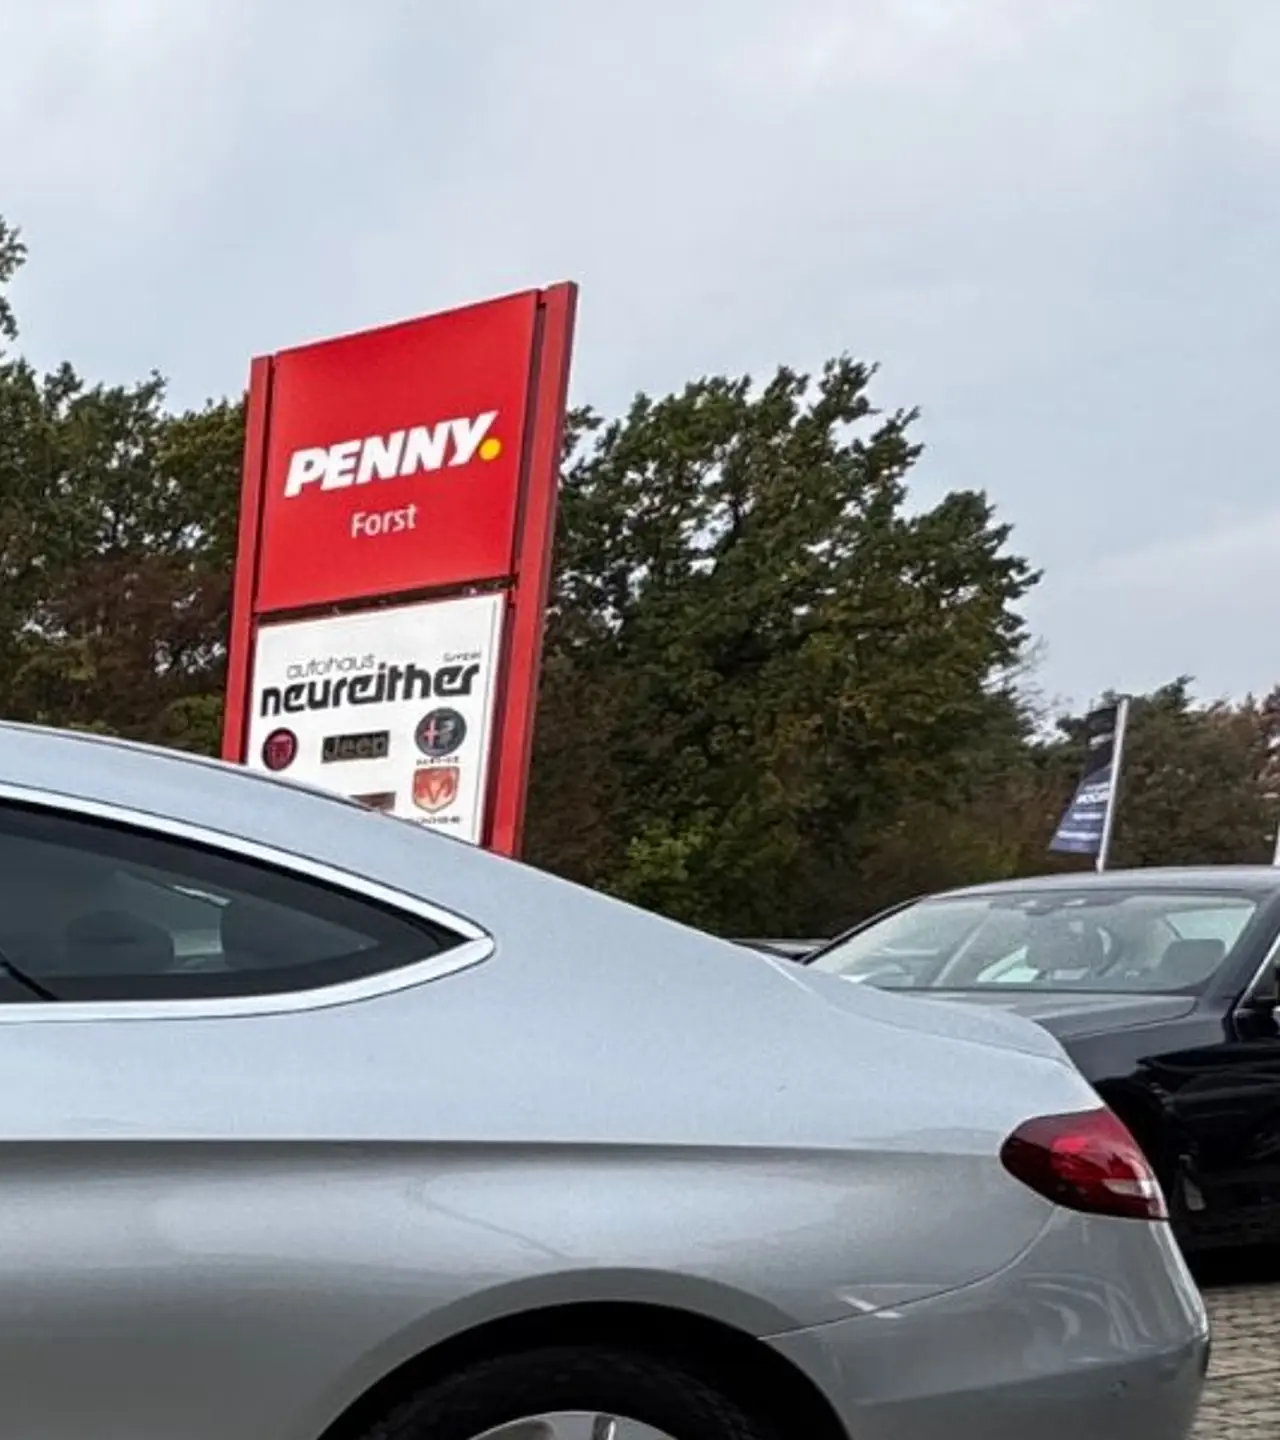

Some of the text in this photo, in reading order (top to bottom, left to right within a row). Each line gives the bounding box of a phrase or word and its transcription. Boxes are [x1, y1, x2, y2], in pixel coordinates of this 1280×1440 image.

[351, 503, 418, 538] Forst
[286, 653, 375, 680] autohaus
[260, 662, 481, 718] neureither
